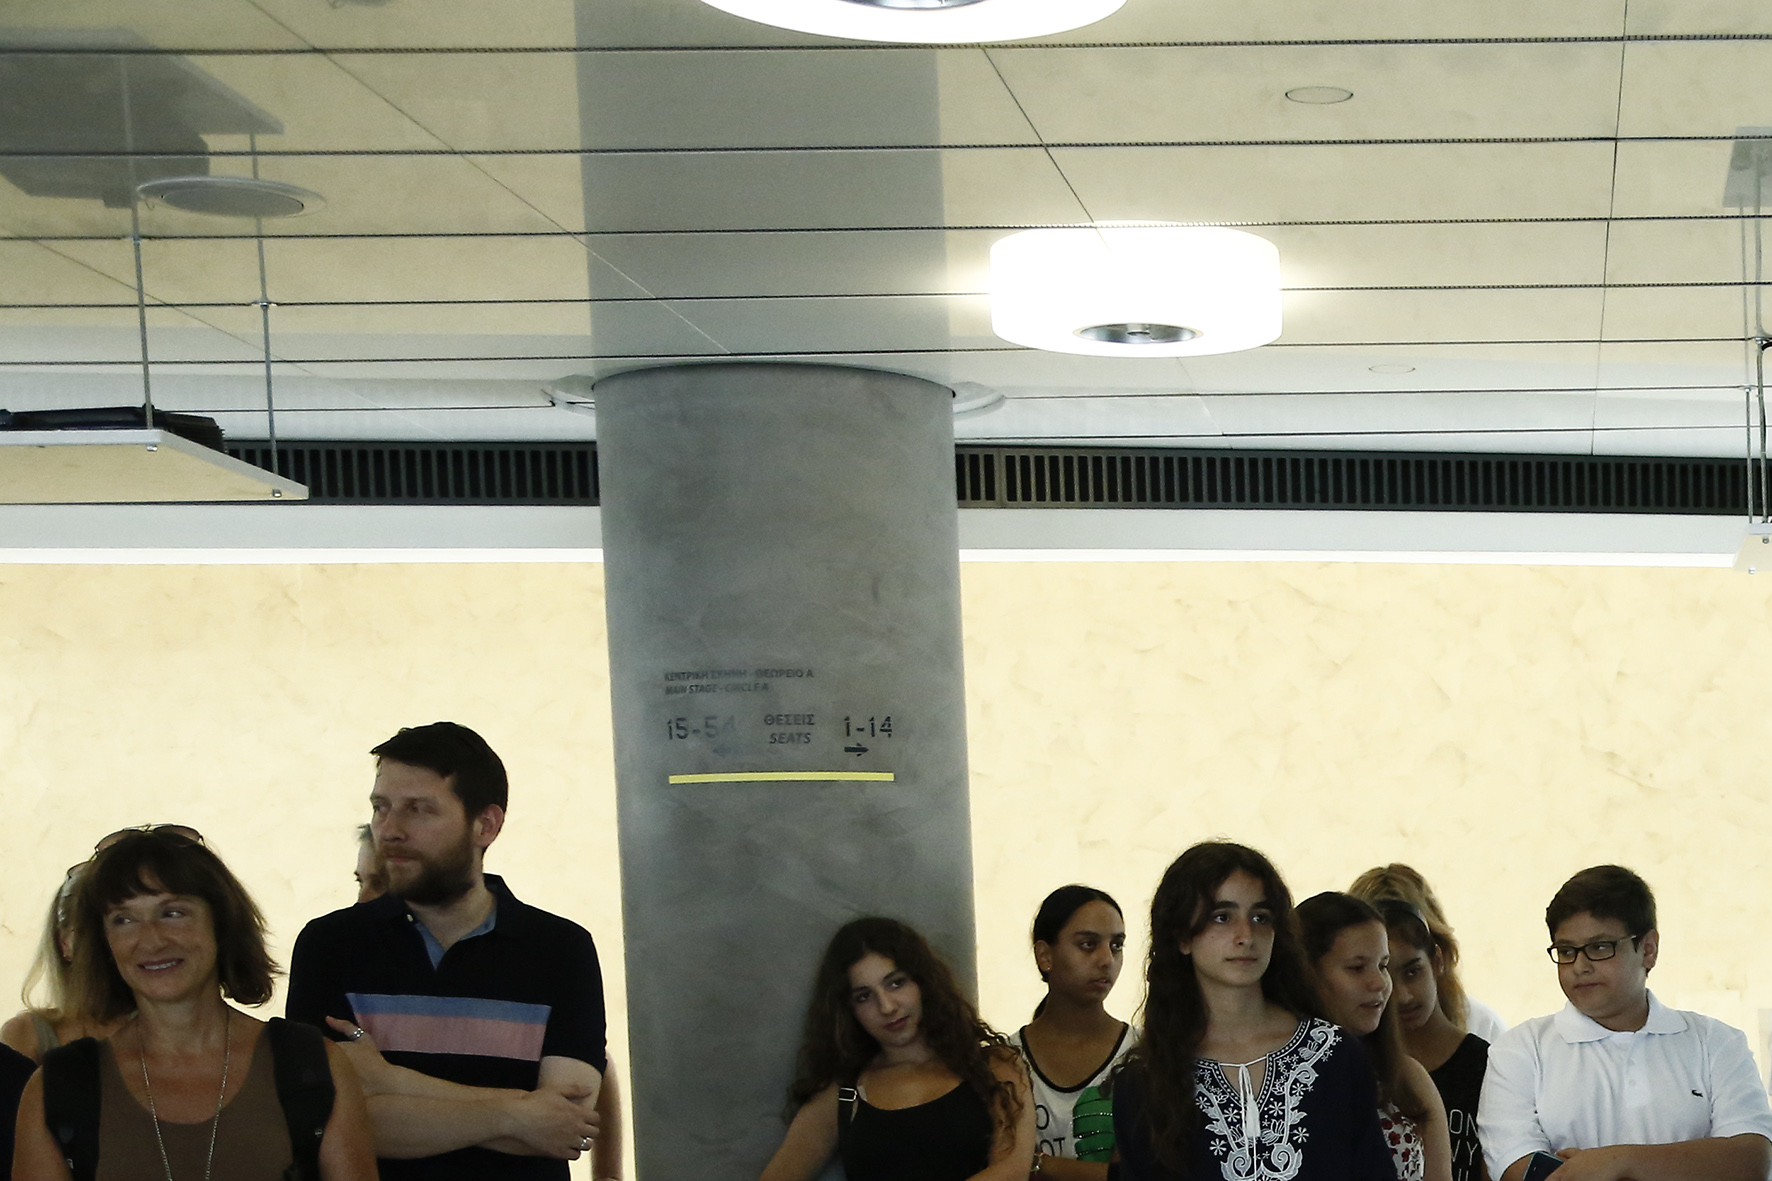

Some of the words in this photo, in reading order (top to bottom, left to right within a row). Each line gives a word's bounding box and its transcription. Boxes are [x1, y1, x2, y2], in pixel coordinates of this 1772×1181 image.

[763, 713, 816, 727] ΘΕΣΕΙΣ
[769, 732, 811, 745] SEATS
[1036, 1137, 1066, 1157] OT
